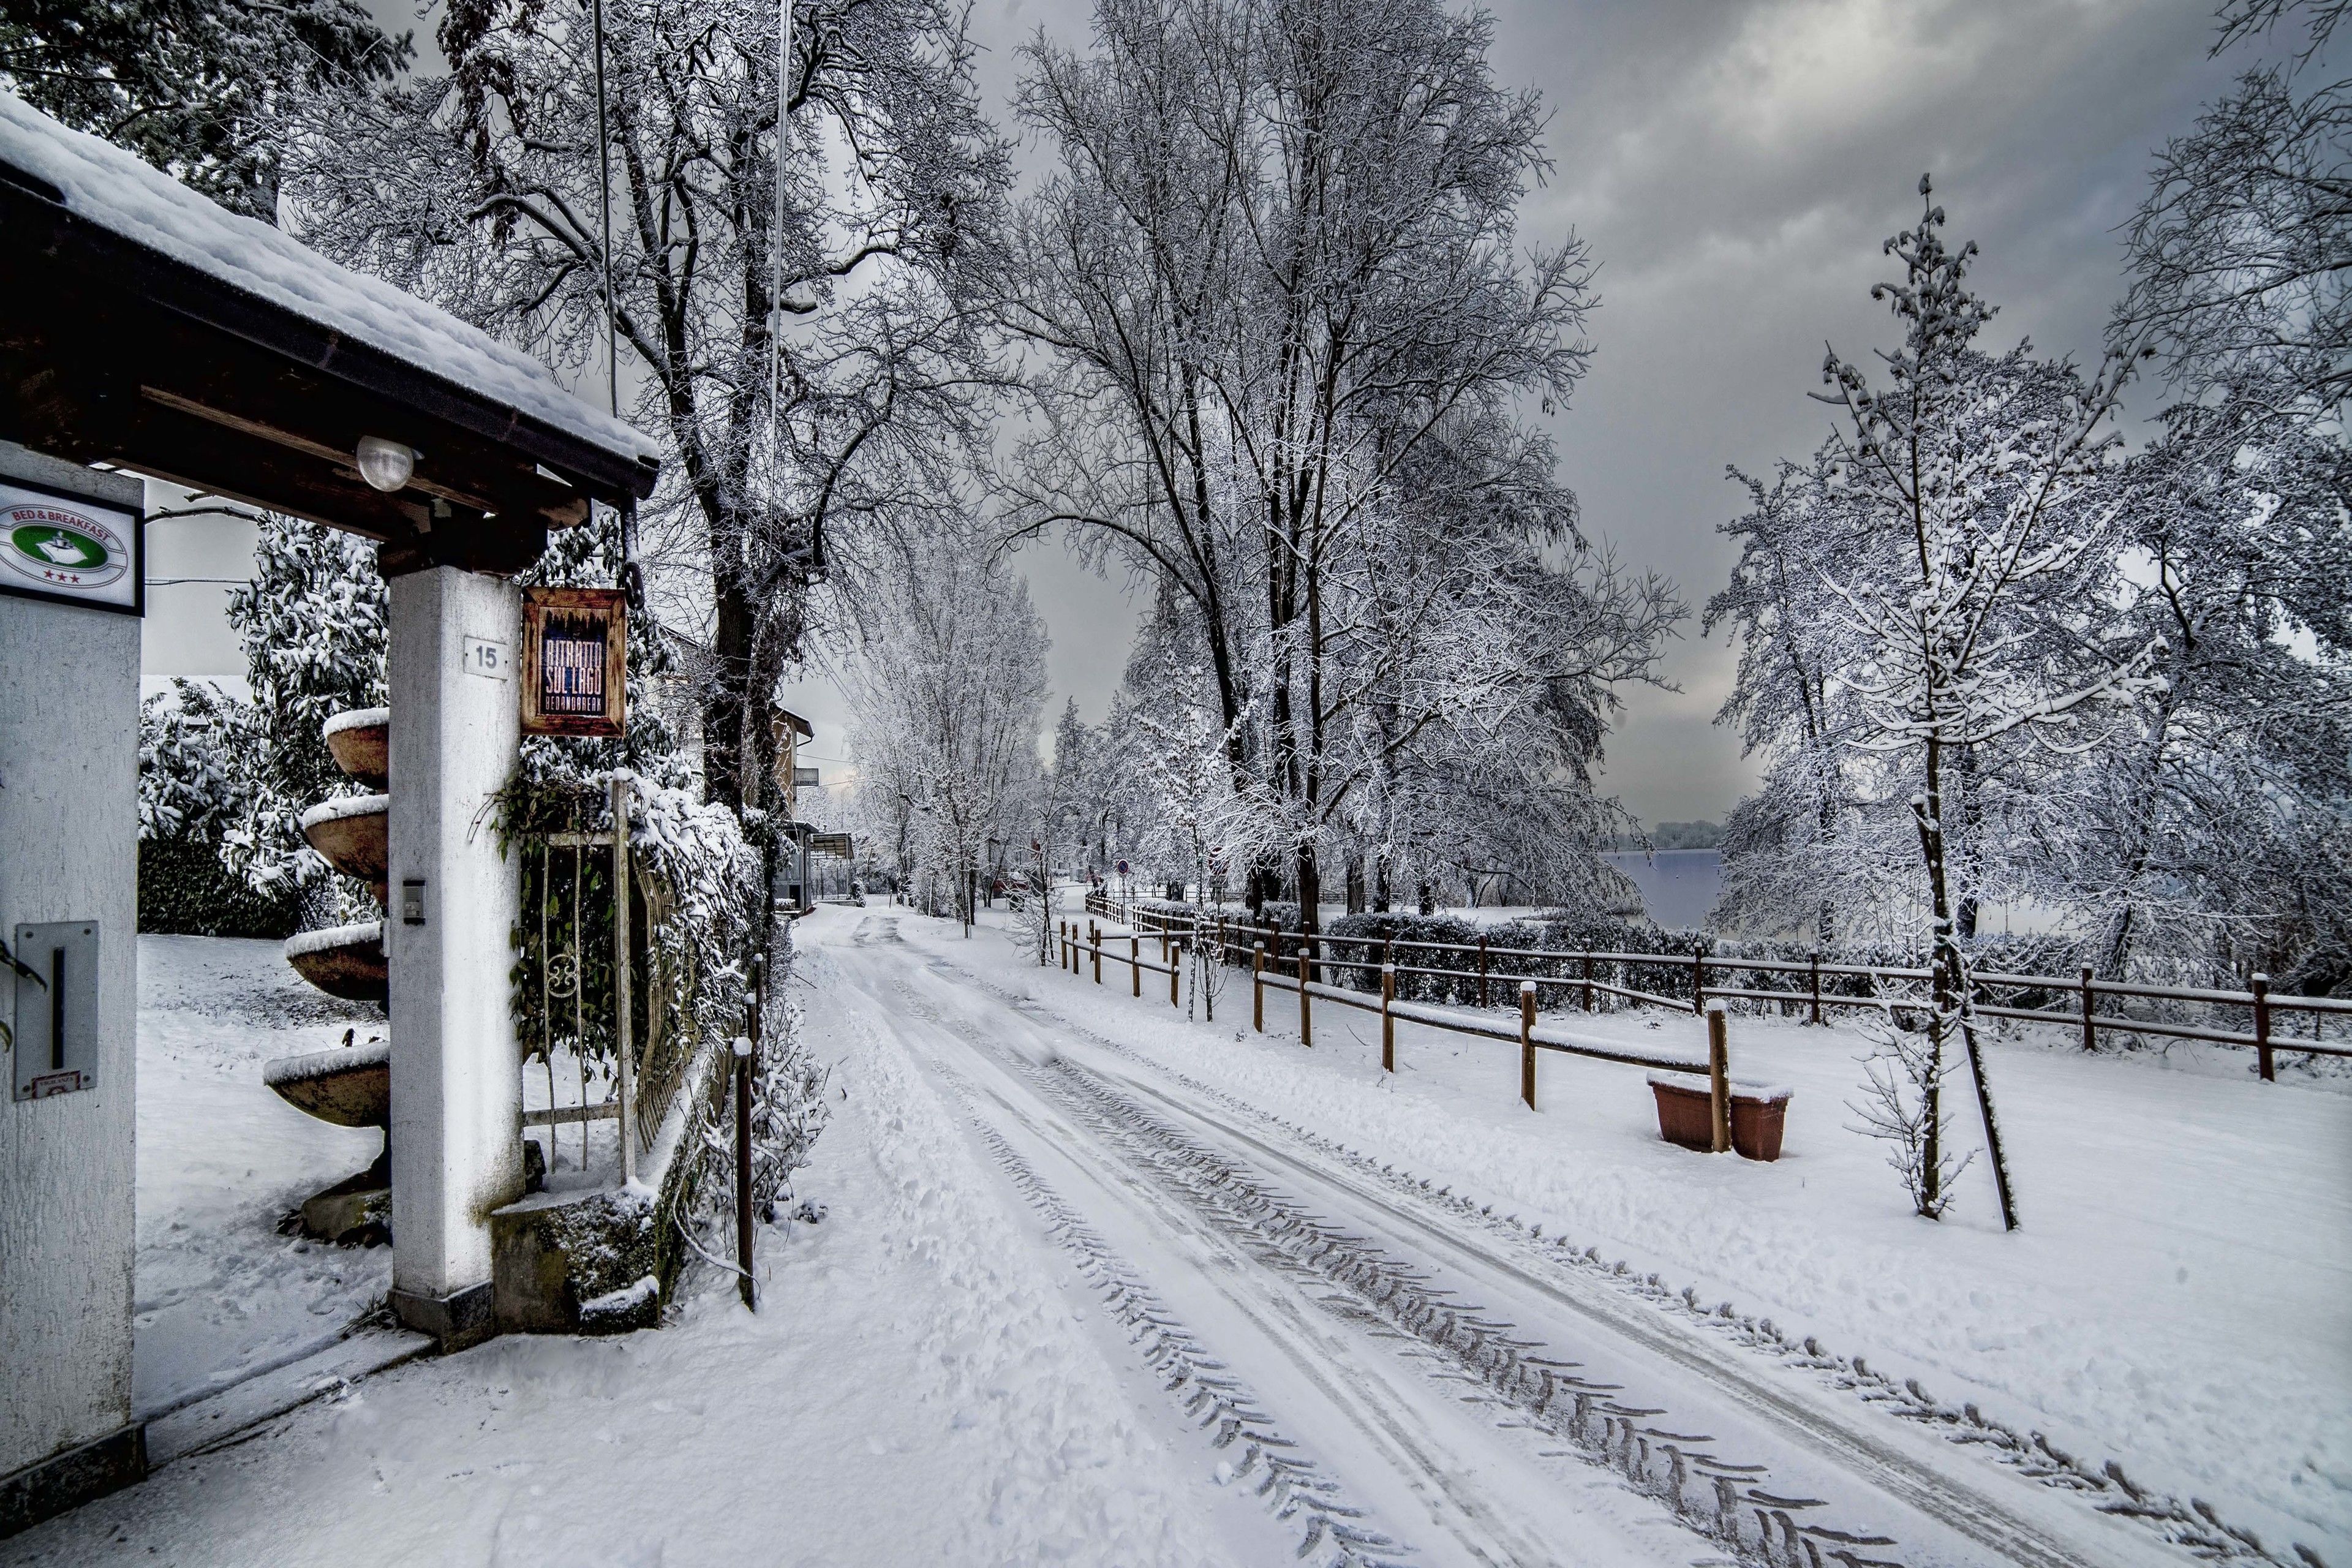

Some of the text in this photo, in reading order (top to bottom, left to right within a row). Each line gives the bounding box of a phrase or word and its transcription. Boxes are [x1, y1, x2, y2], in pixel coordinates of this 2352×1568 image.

[12, 510, 111, 541] BED & BREAKFAST
[476, 645, 497, 669] 15
[546, 639, 602, 668] RITRATTO
[546, 667, 601, 695] SUL LAGO
[546, 696, 601, 712] BEDANDBREAK
